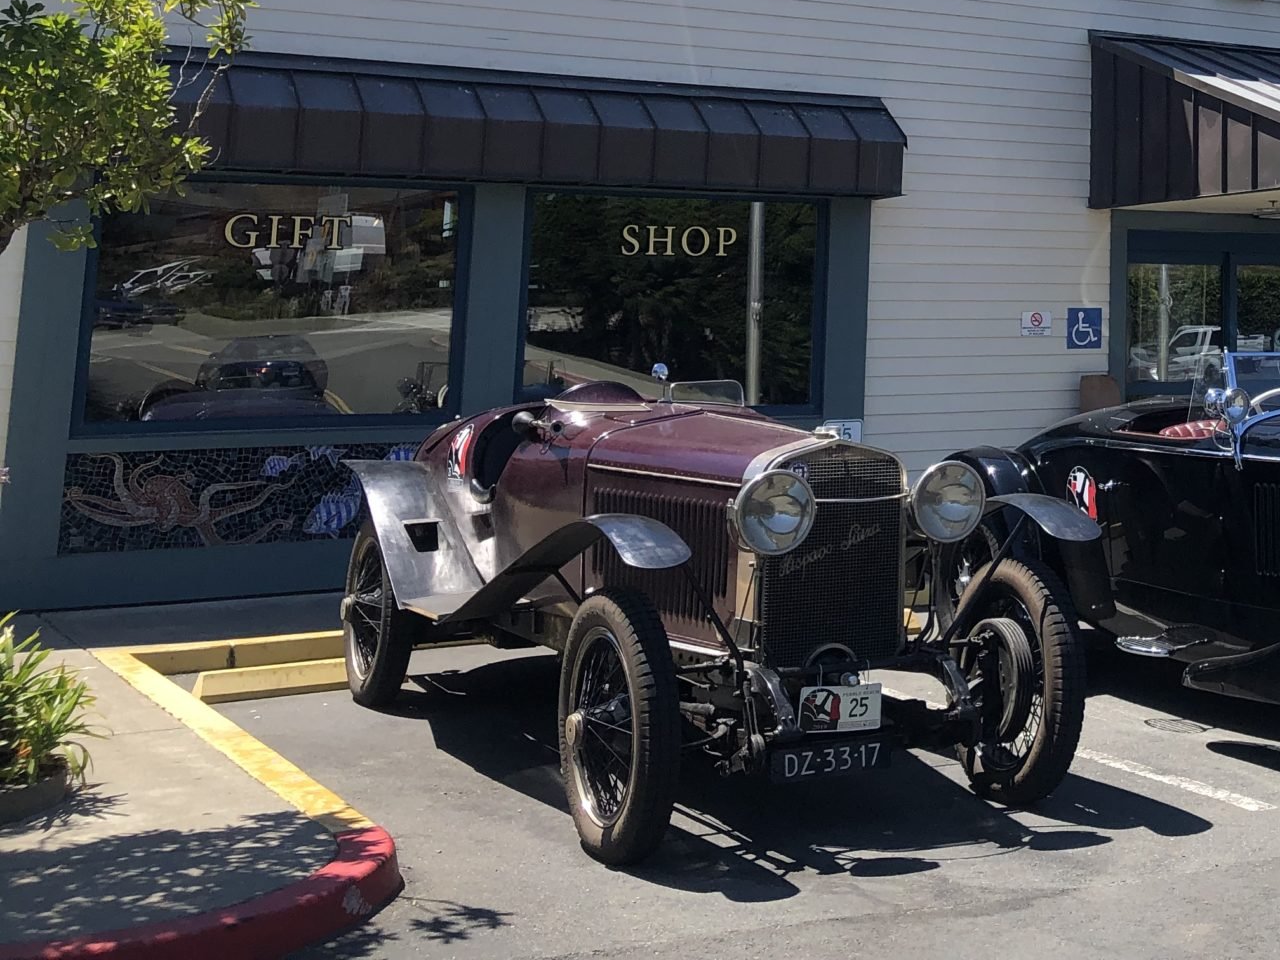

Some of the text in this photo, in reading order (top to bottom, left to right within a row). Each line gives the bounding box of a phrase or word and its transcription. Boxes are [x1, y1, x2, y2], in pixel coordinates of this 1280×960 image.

[224, 213, 738, 257] GIFT SHOP
[848, 696, 870, 718] 25
